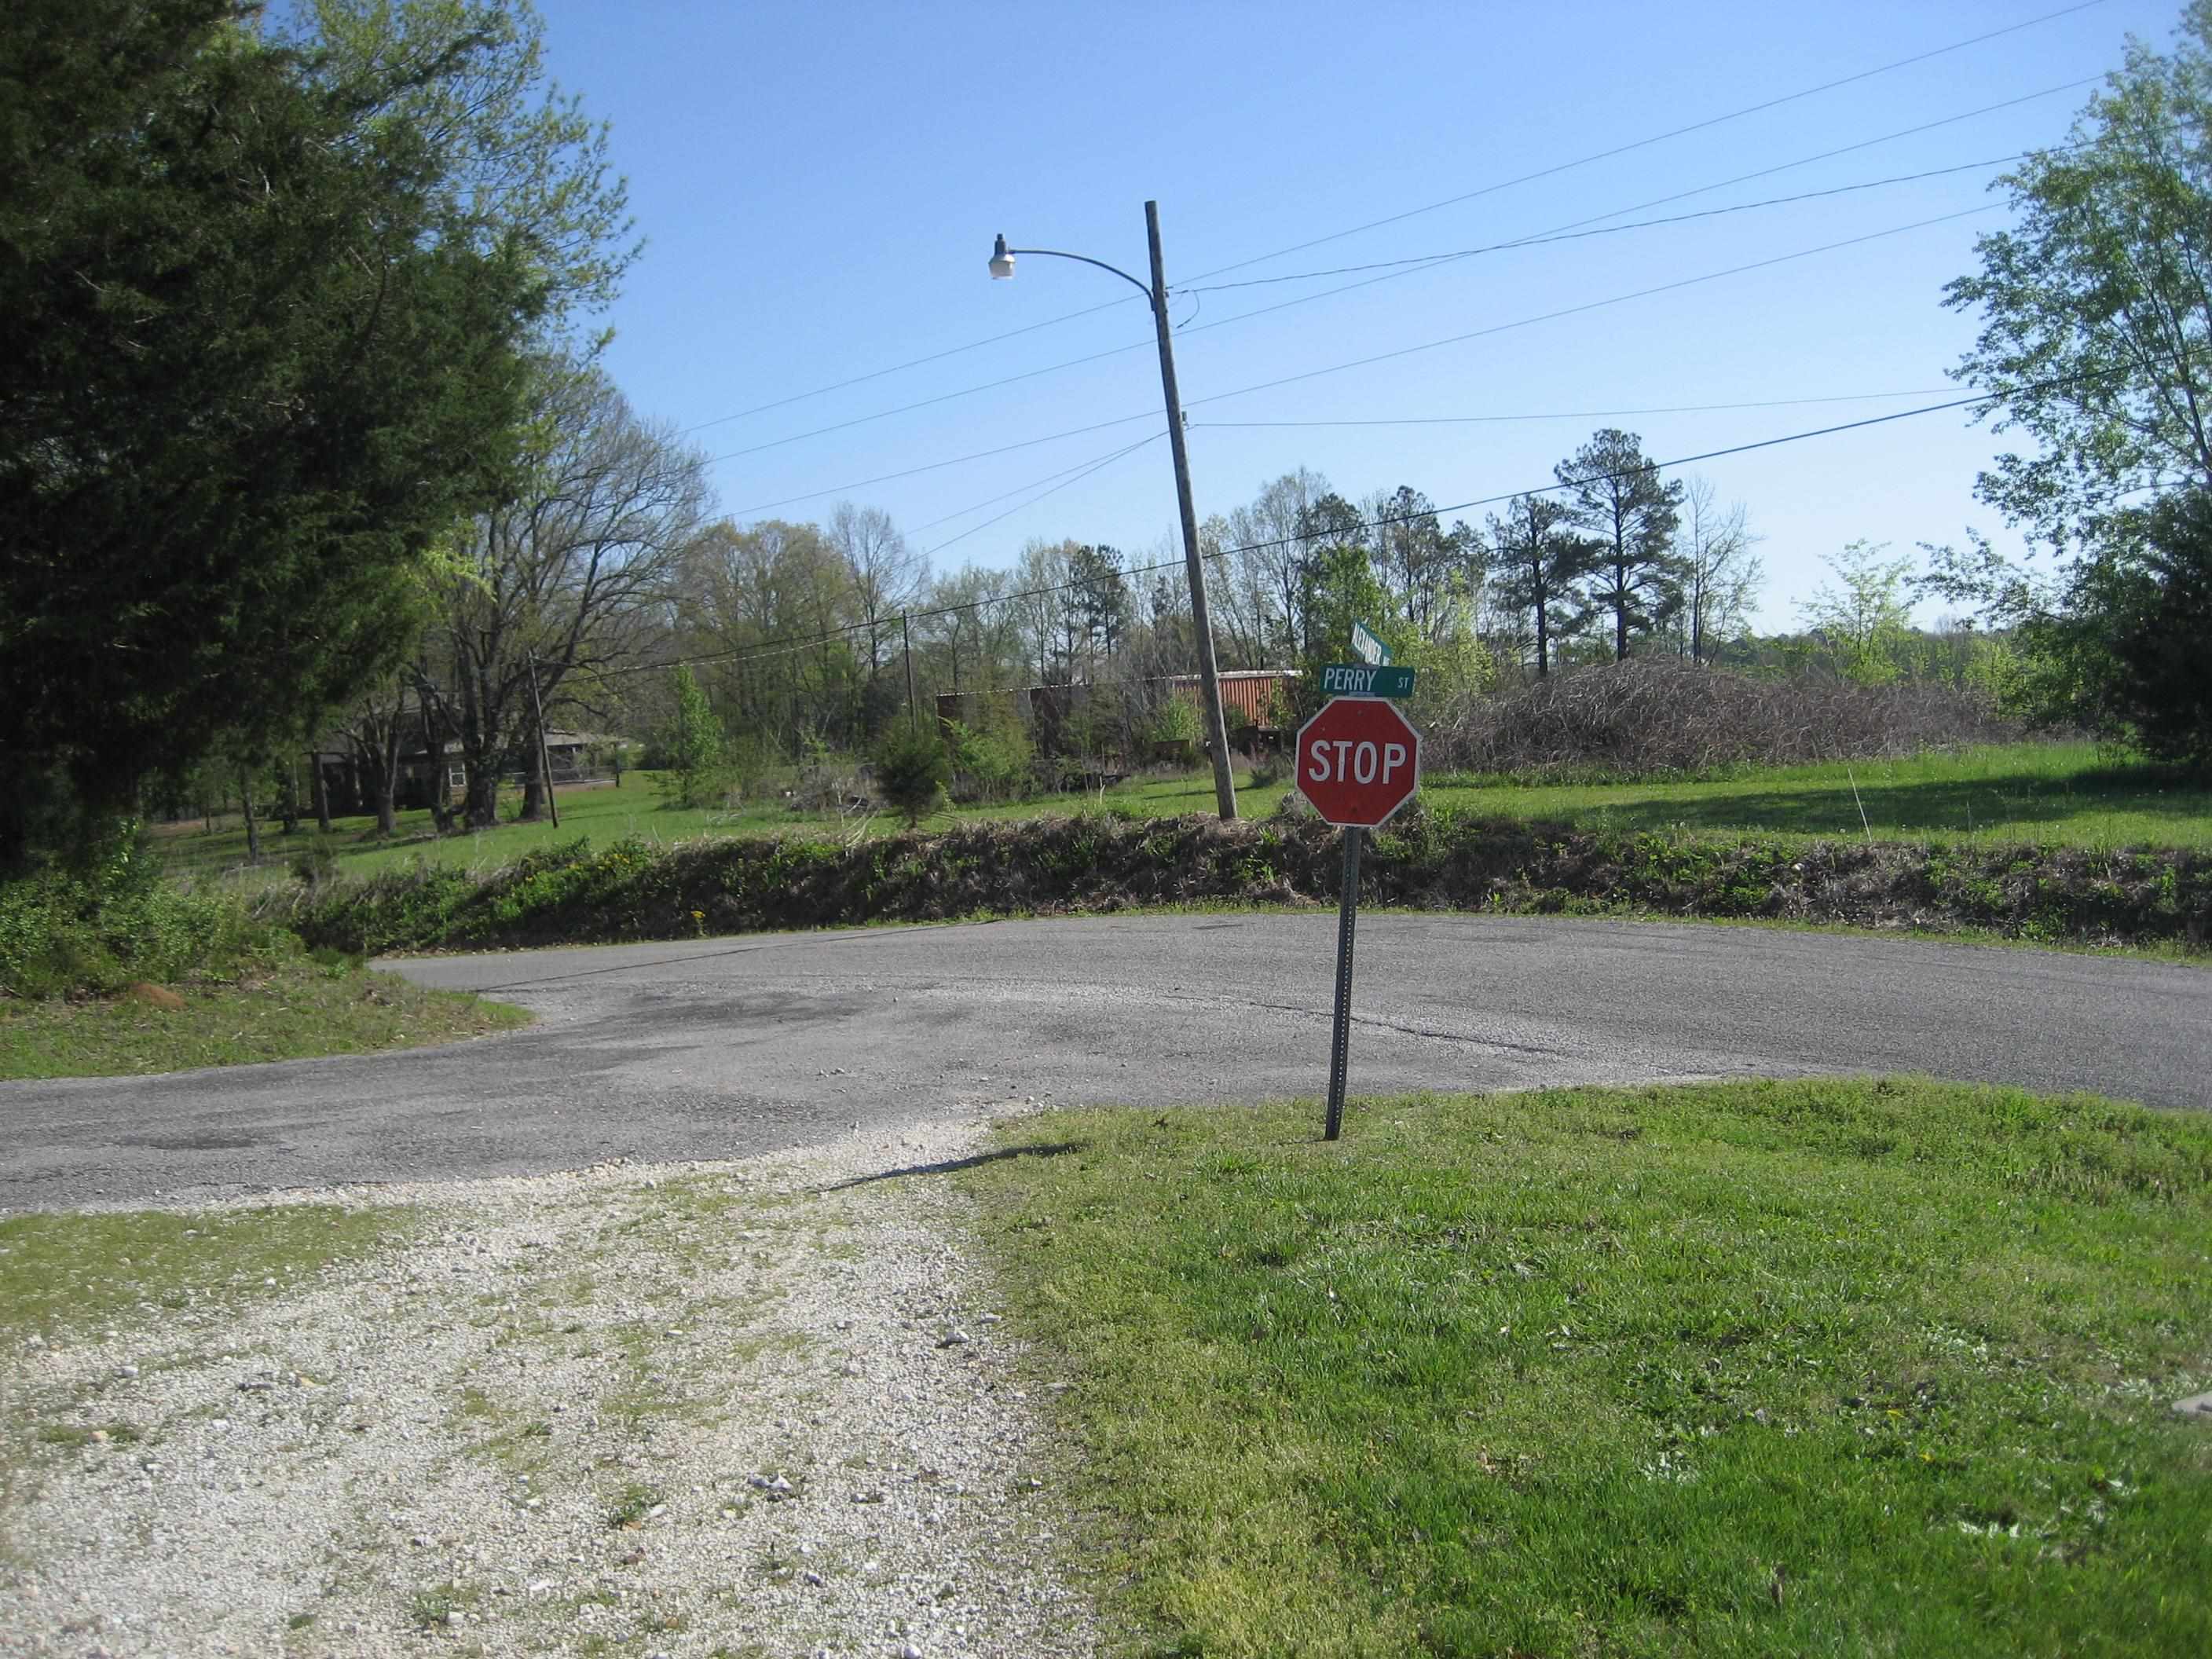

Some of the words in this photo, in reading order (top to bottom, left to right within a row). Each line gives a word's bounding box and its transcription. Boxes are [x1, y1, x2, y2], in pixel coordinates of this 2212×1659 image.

[1324, 668, 1376, 691] PERRY
[1397, 677, 1409, 689] ST
[1309, 740, 1407, 784] STOP
